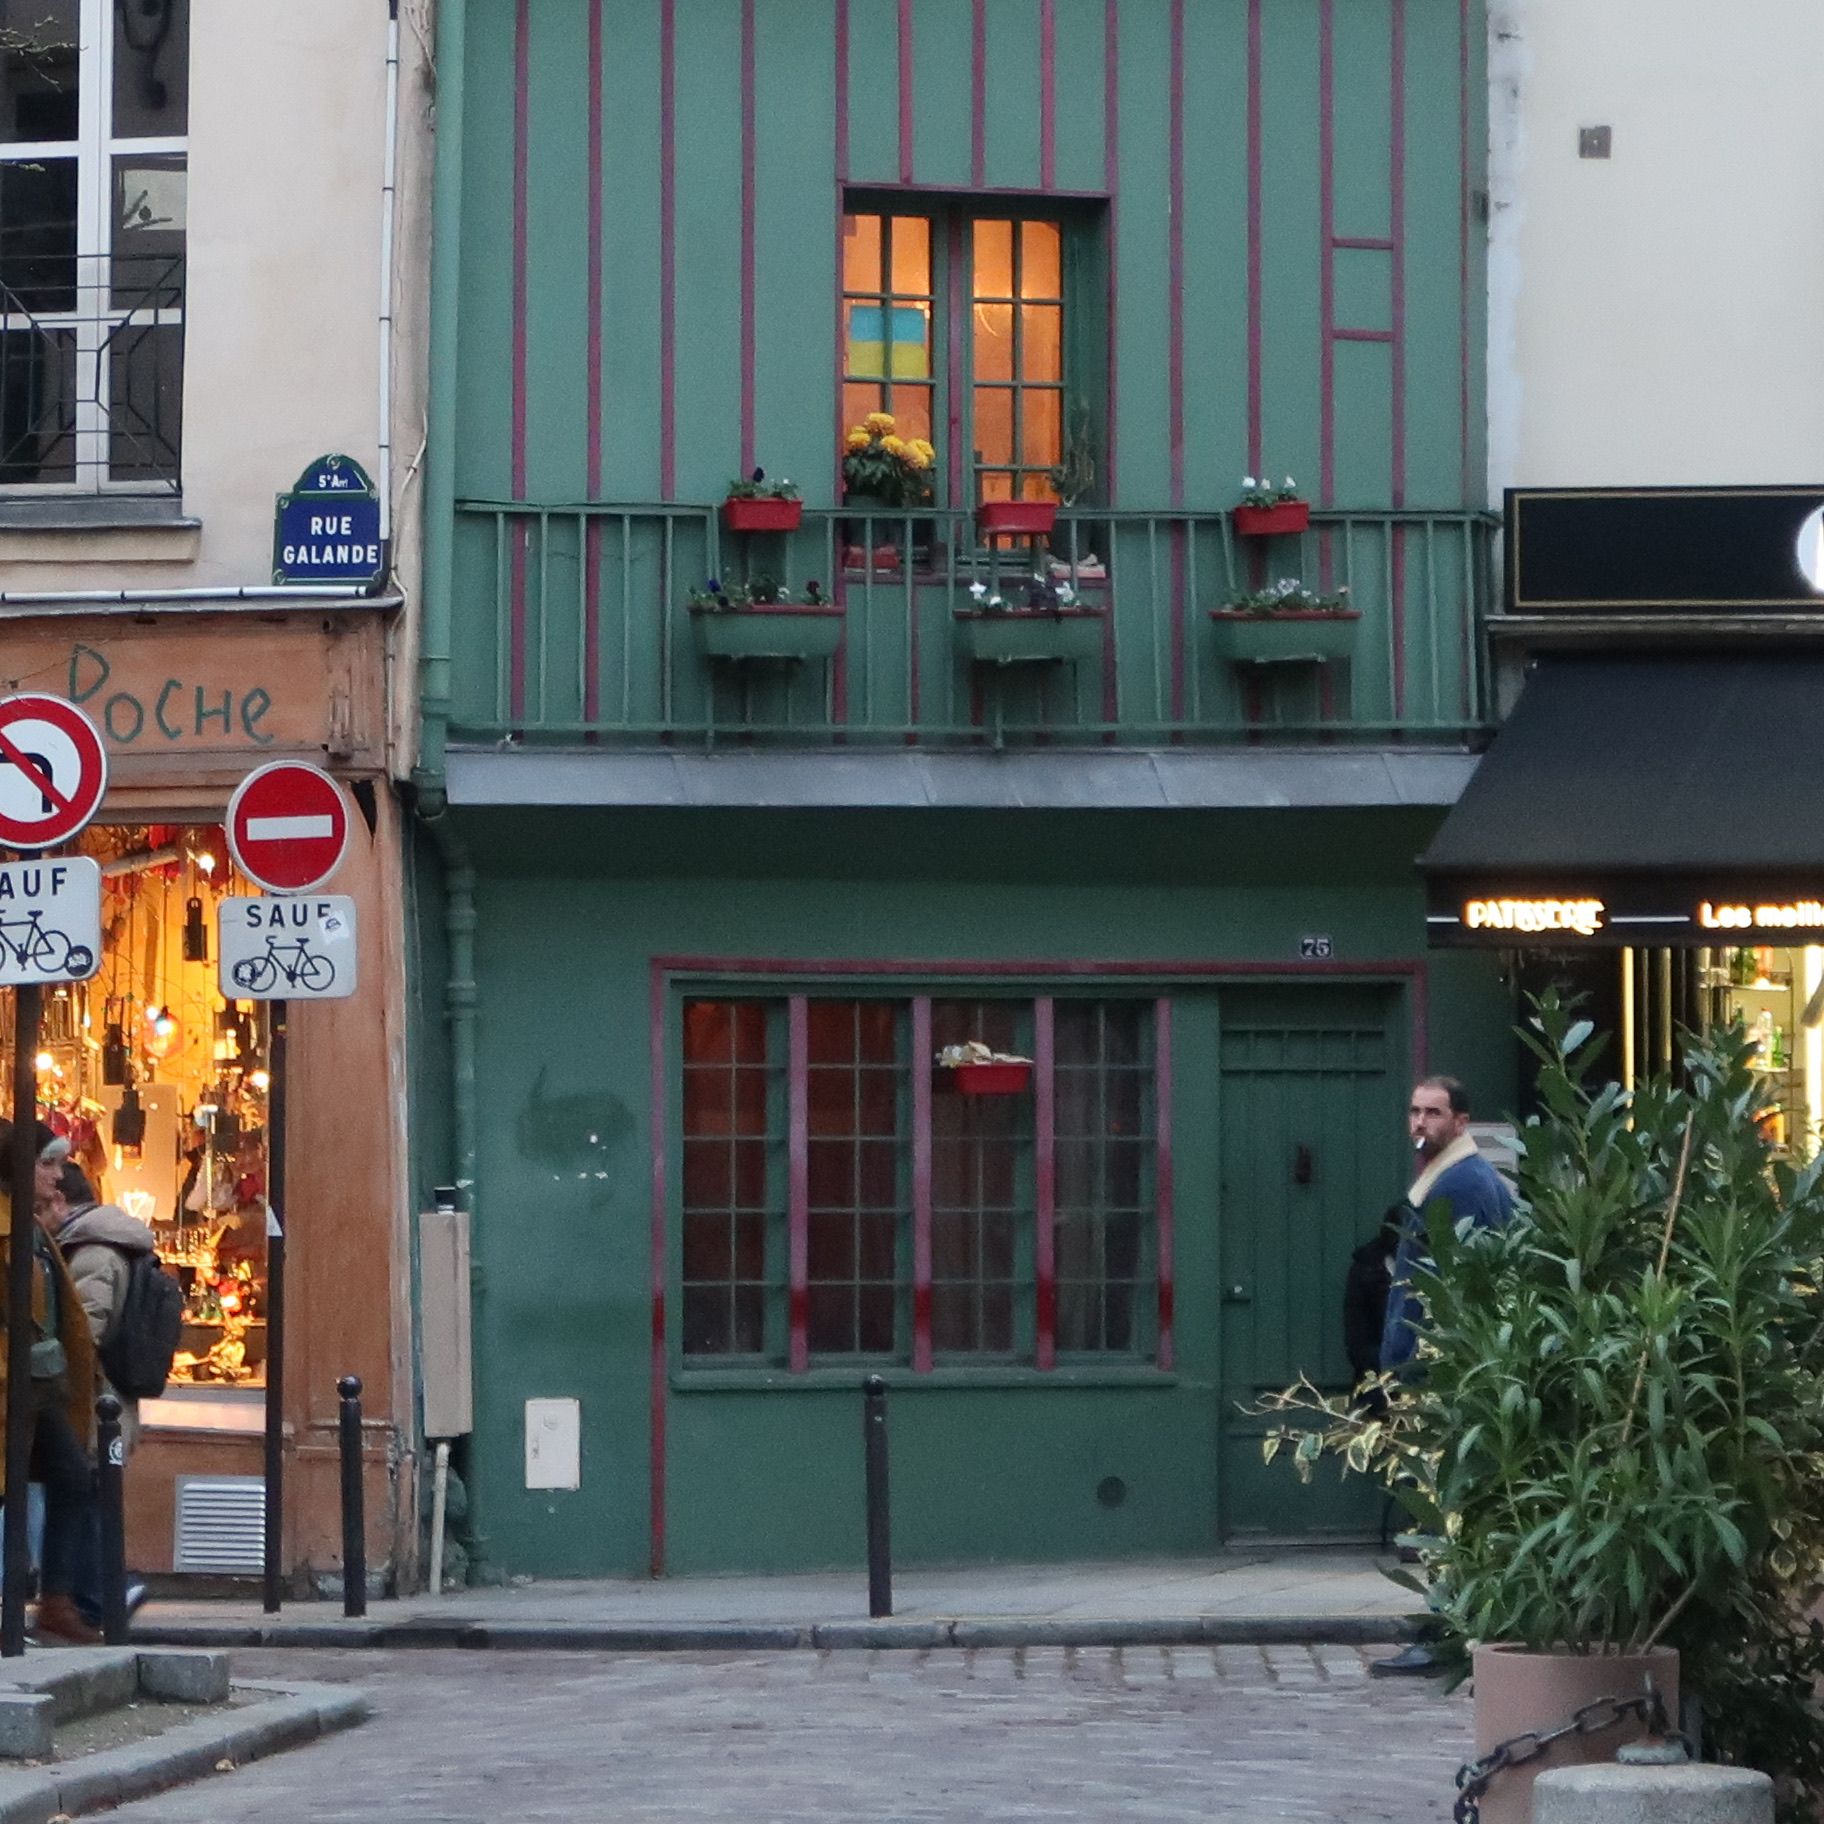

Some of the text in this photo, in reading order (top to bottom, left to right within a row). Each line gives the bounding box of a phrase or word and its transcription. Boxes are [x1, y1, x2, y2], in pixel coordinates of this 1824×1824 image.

[310, 516, 353, 536] RUE
[282, 544, 379, 565] GALANDE
[1700, 901, 1753, 928] Les
[1303, 938, 1330, 957] 75
